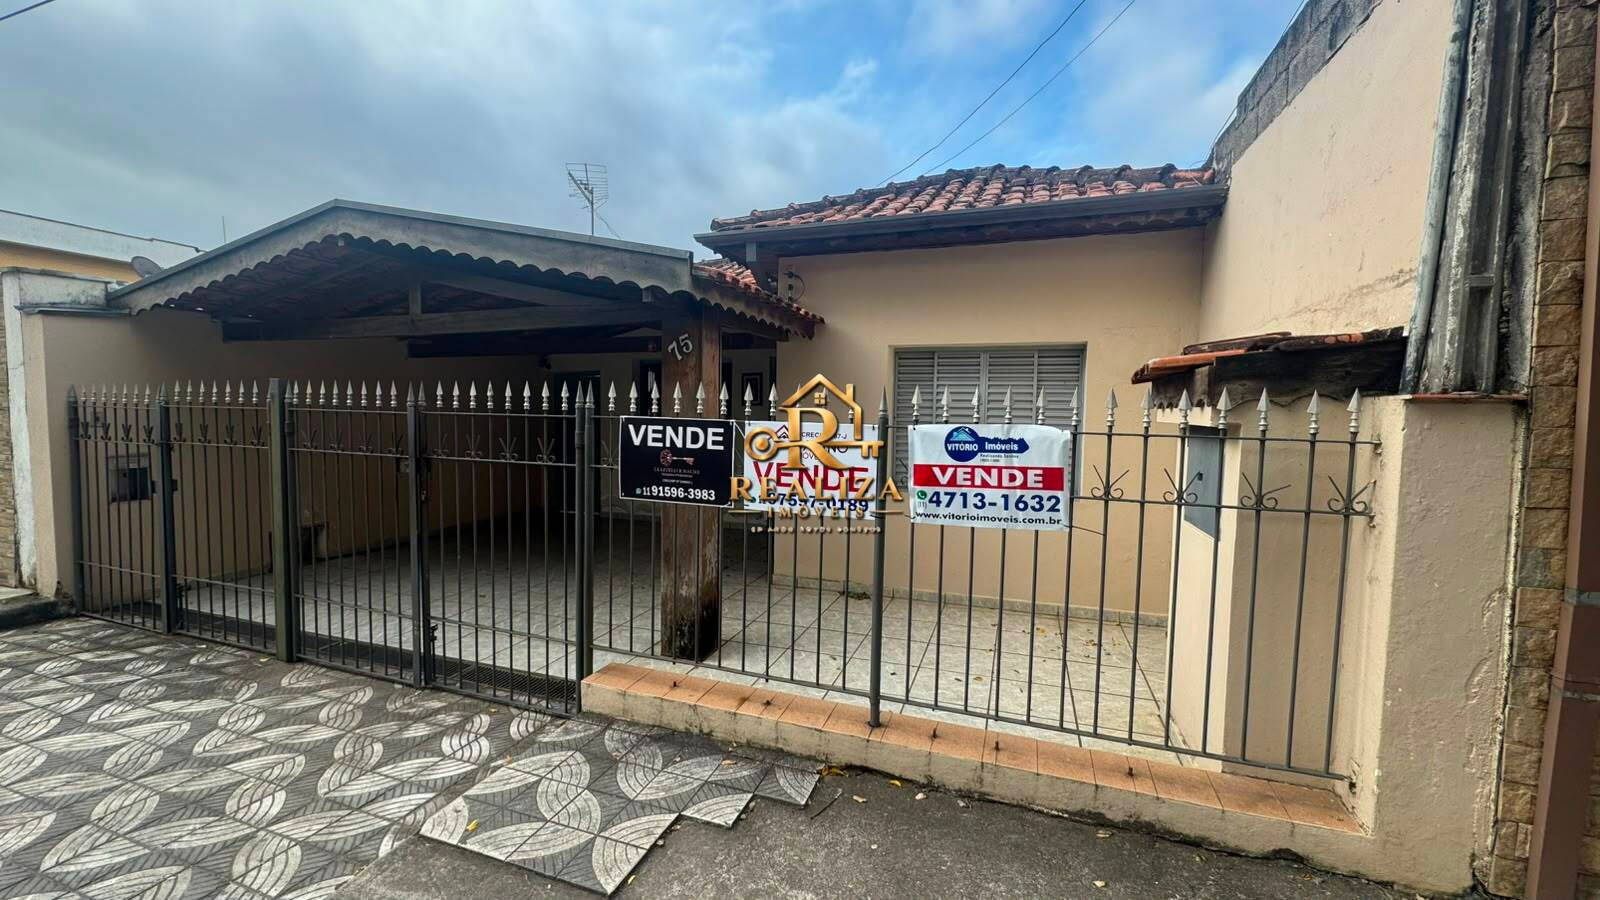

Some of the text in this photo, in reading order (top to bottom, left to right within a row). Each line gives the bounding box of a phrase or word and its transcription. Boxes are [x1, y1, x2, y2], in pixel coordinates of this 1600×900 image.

[667, 333, 693, 361] 75
[628, 423, 725, 451] VENDE
[801, 431, 822, 439] CREC
[984, 441, 1019, 451] Imóveis
[752, 460, 869, 493] VENDE
[931, 465, 1045, 489] VENDE
[642, 484, 716, 501] 11 91596-3983
[928, 490, 1062, 513] 4713-1632
[915, 511, 1063, 525] www.vitorioimoveis.com.br
